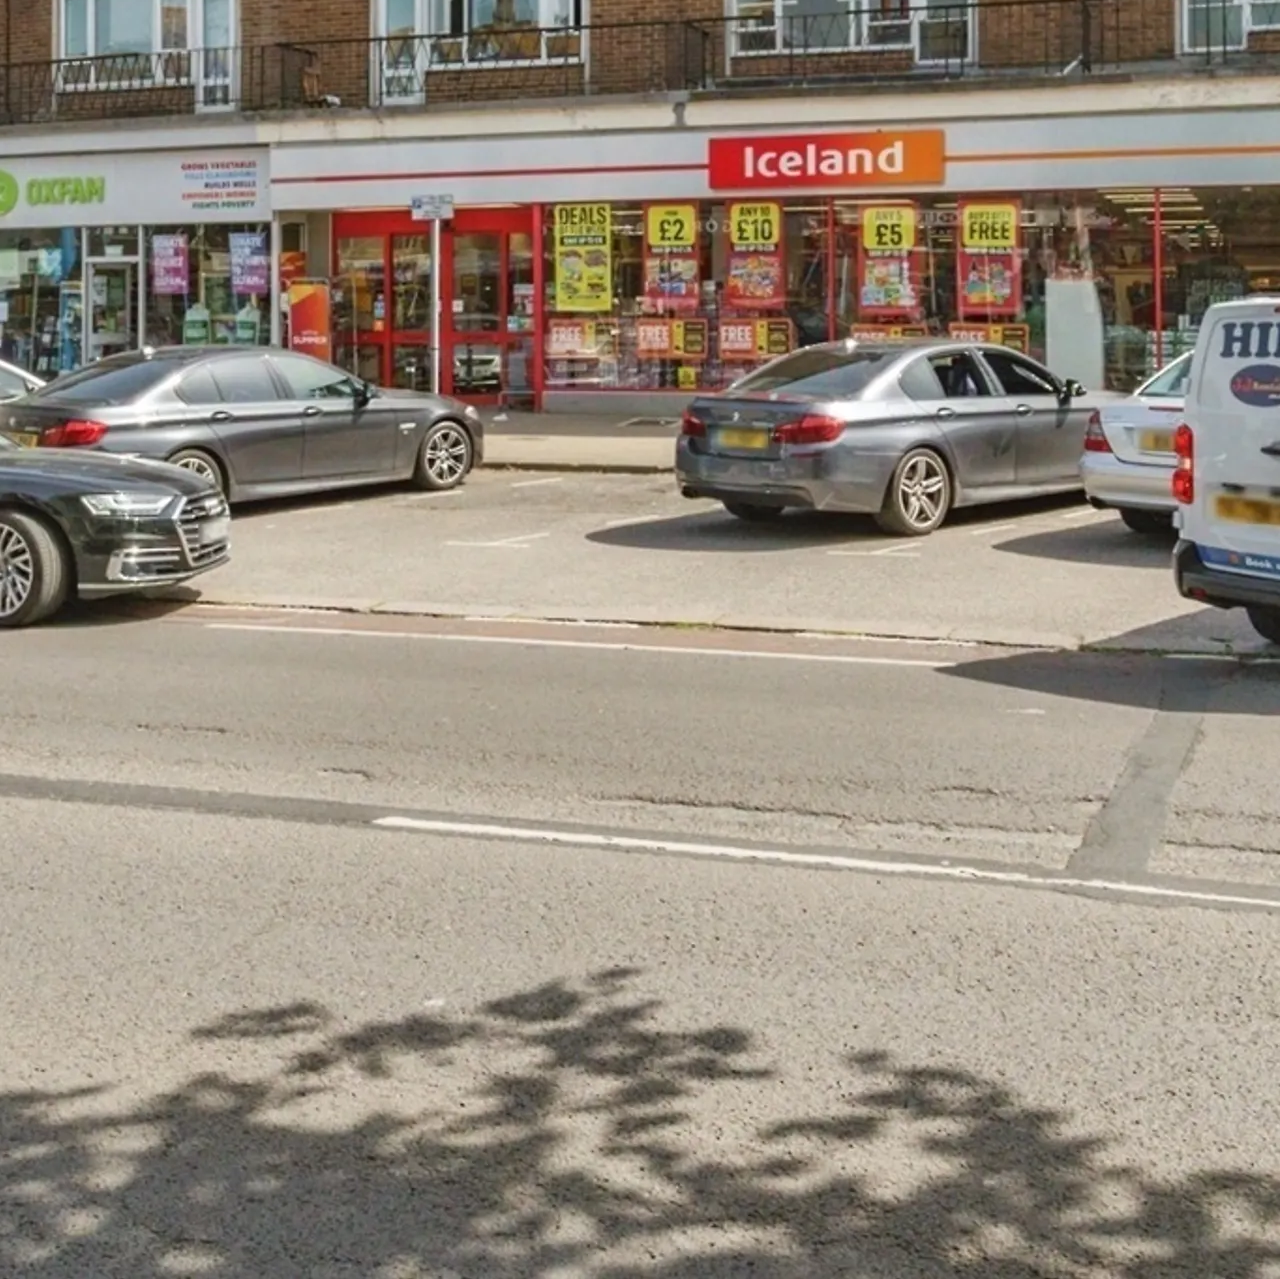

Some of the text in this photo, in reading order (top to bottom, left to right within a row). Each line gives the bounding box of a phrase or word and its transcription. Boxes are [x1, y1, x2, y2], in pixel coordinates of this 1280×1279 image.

[744, 140, 904, 178] Iceland
[26, 177, 106, 206] OXFAM
[559, 206, 607, 225] DEALS
[659, 219, 685, 241] £2
[736, 219, 773, 241] £10
[875, 223, 903, 246] £5
[969, 221, 1010, 241] FREE
[638, 325, 669, 341] FREE
[721, 326, 752, 341] FREE
[1245, 557, 1273, 570] Book
